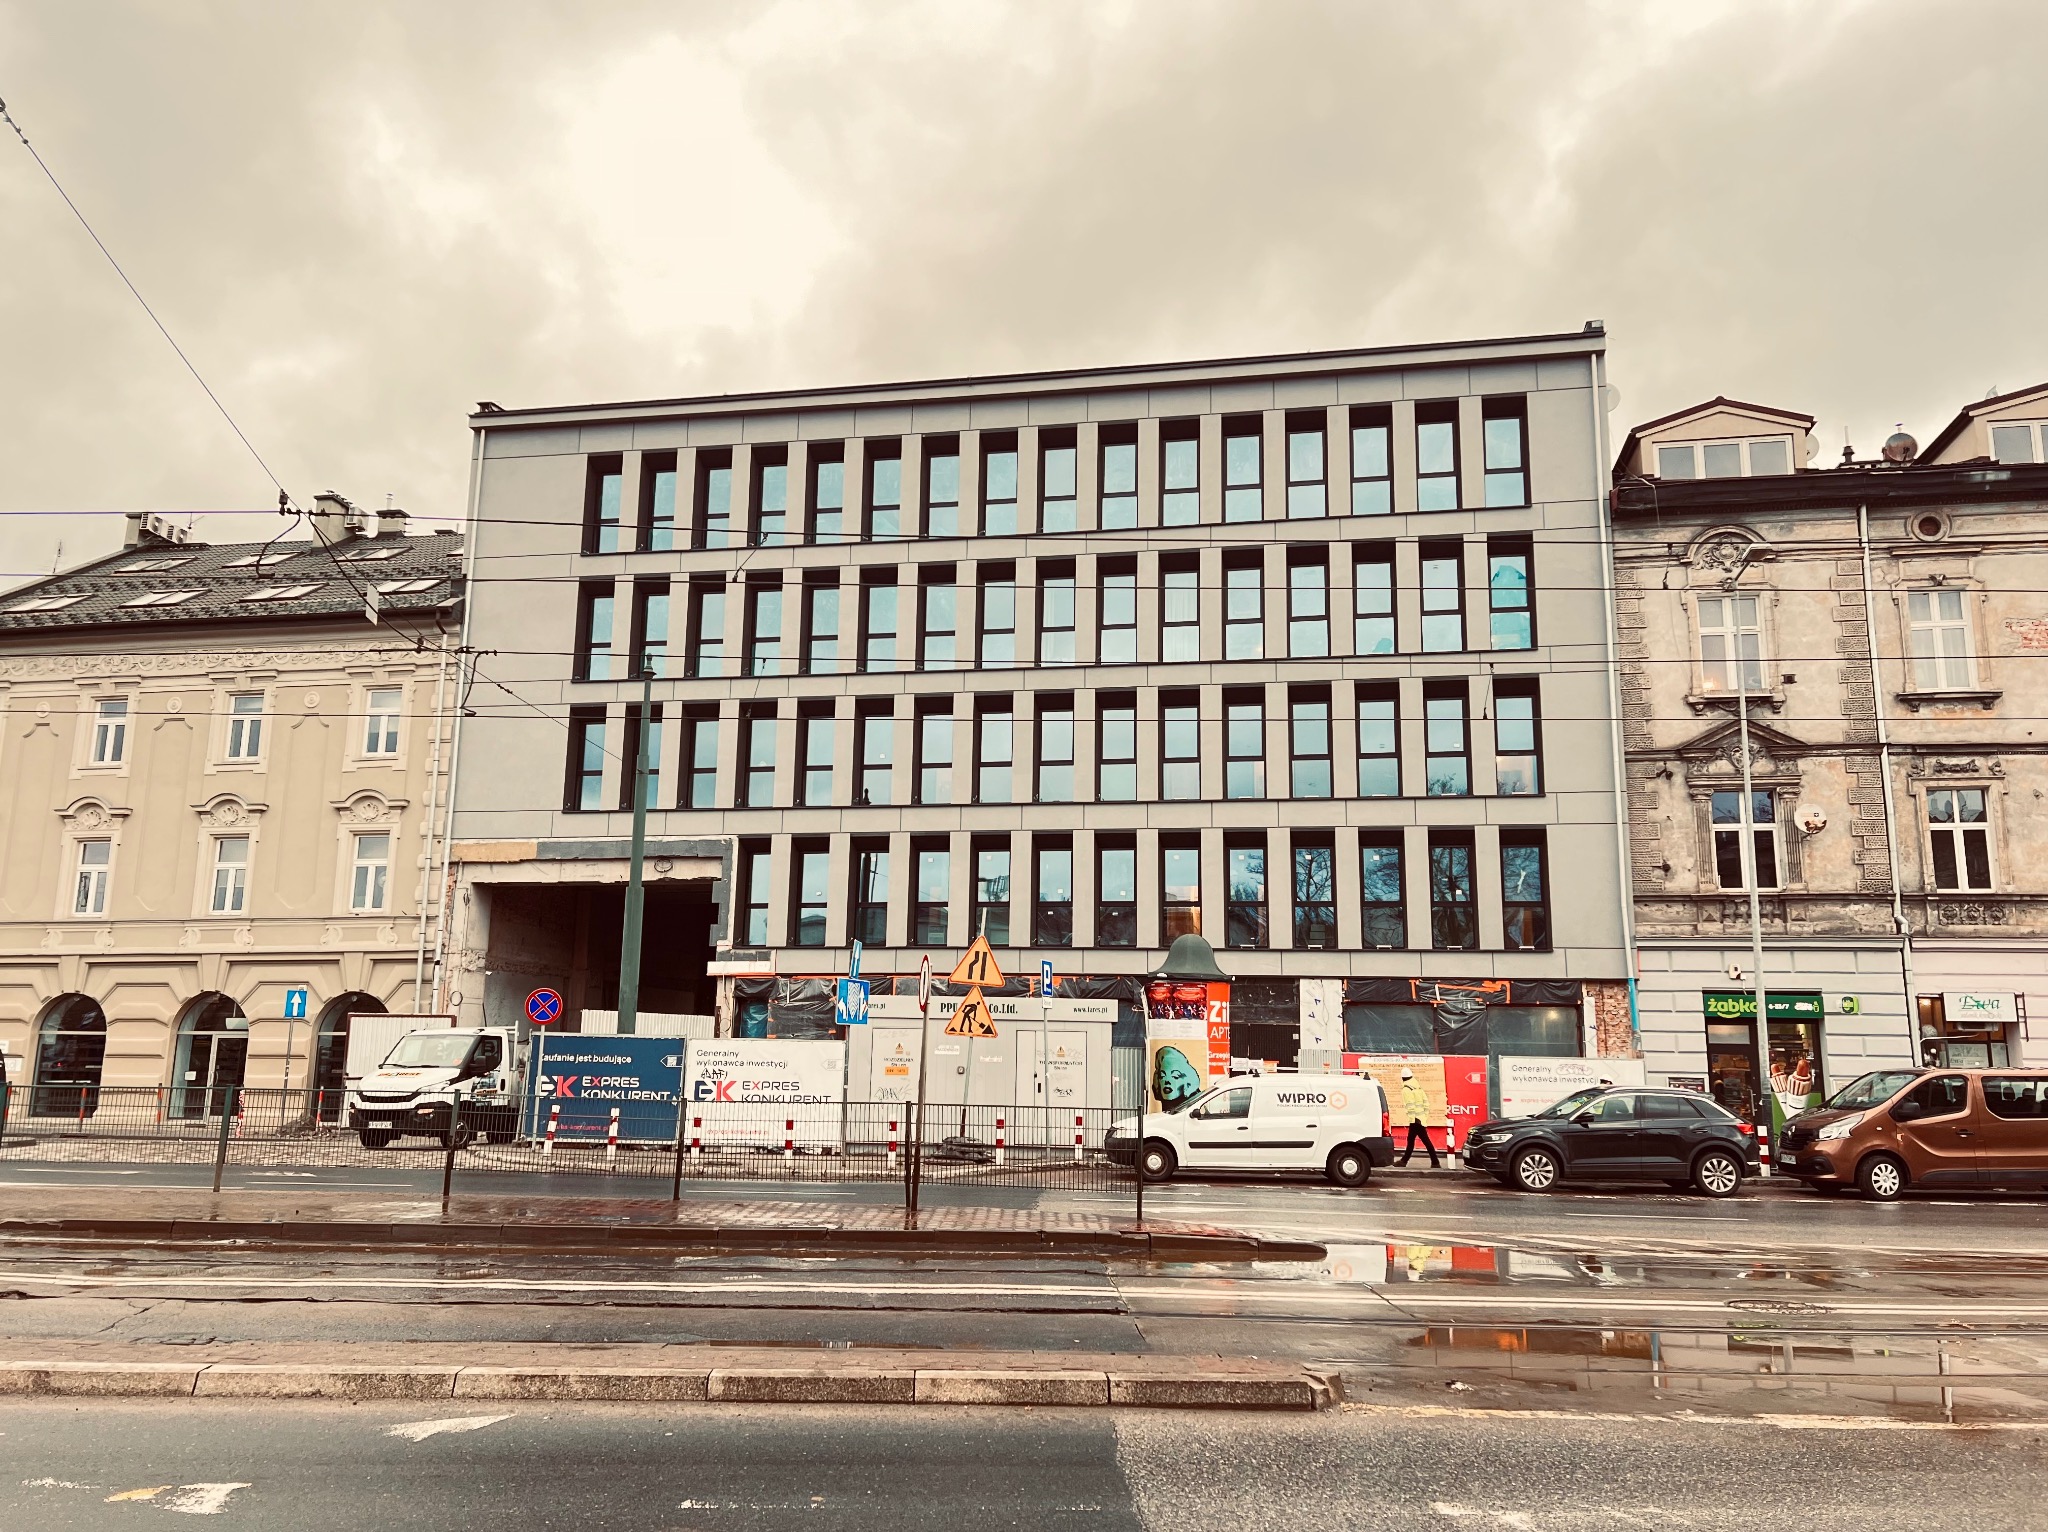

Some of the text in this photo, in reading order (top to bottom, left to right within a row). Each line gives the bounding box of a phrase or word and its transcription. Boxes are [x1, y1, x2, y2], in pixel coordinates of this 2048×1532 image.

[940, 1002, 958, 1013] PPU
[696, 1049, 739, 1058] Generalny
[575, 1054, 592, 1064] jest
[593, 1054, 632, 1065] budujące
[746, 1060, 788, 1069] inwestycji
[1511, 1064, 1552, 1073] Generalny
[582, 1075, 640, 1088] EXPRES
[1512, 1075, 1599, 1085] wykonawca inwestycji
[742, 1081, 800, 1091] EXPRES
[581, 1089, 671, 1101] KONKURENT
[741, 1094, 832, 1104] KONKURENT
[1277, 1093, 1327, 1104] WIPRO
